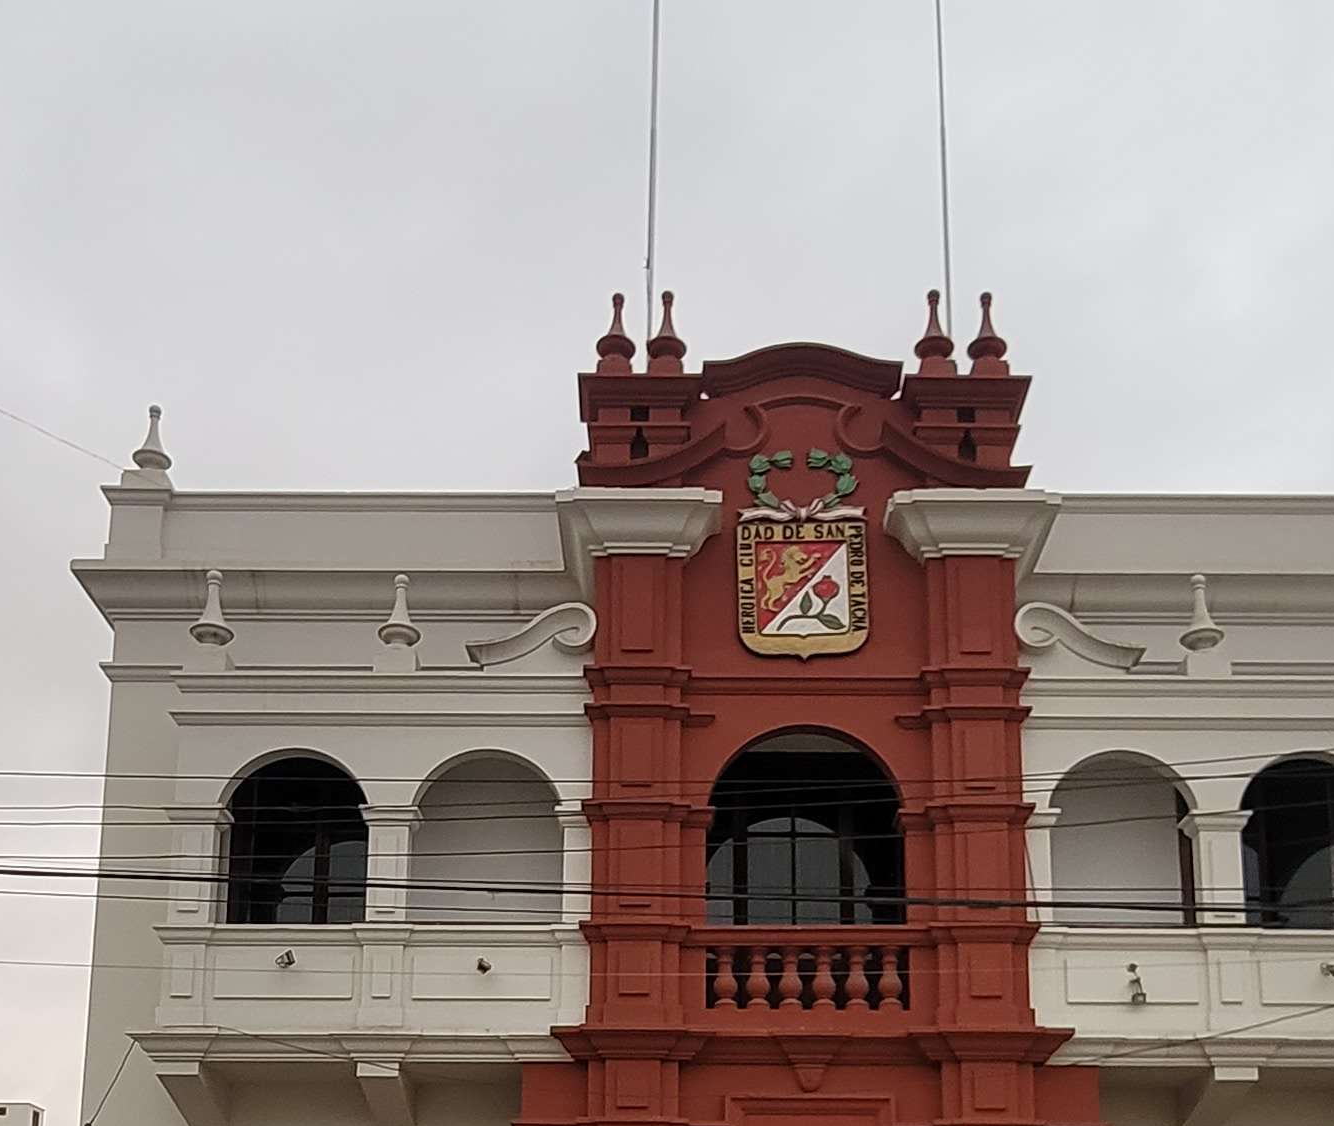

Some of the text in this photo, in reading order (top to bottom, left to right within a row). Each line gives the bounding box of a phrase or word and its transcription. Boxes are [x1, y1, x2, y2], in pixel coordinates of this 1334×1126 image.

[782, 525, 805, 539] DE
[813, 524, 845, 539] SAN
[741, 578, 756, 634] HEROICA
[848, 525, 867, 632] PEDRO DE TACNA
